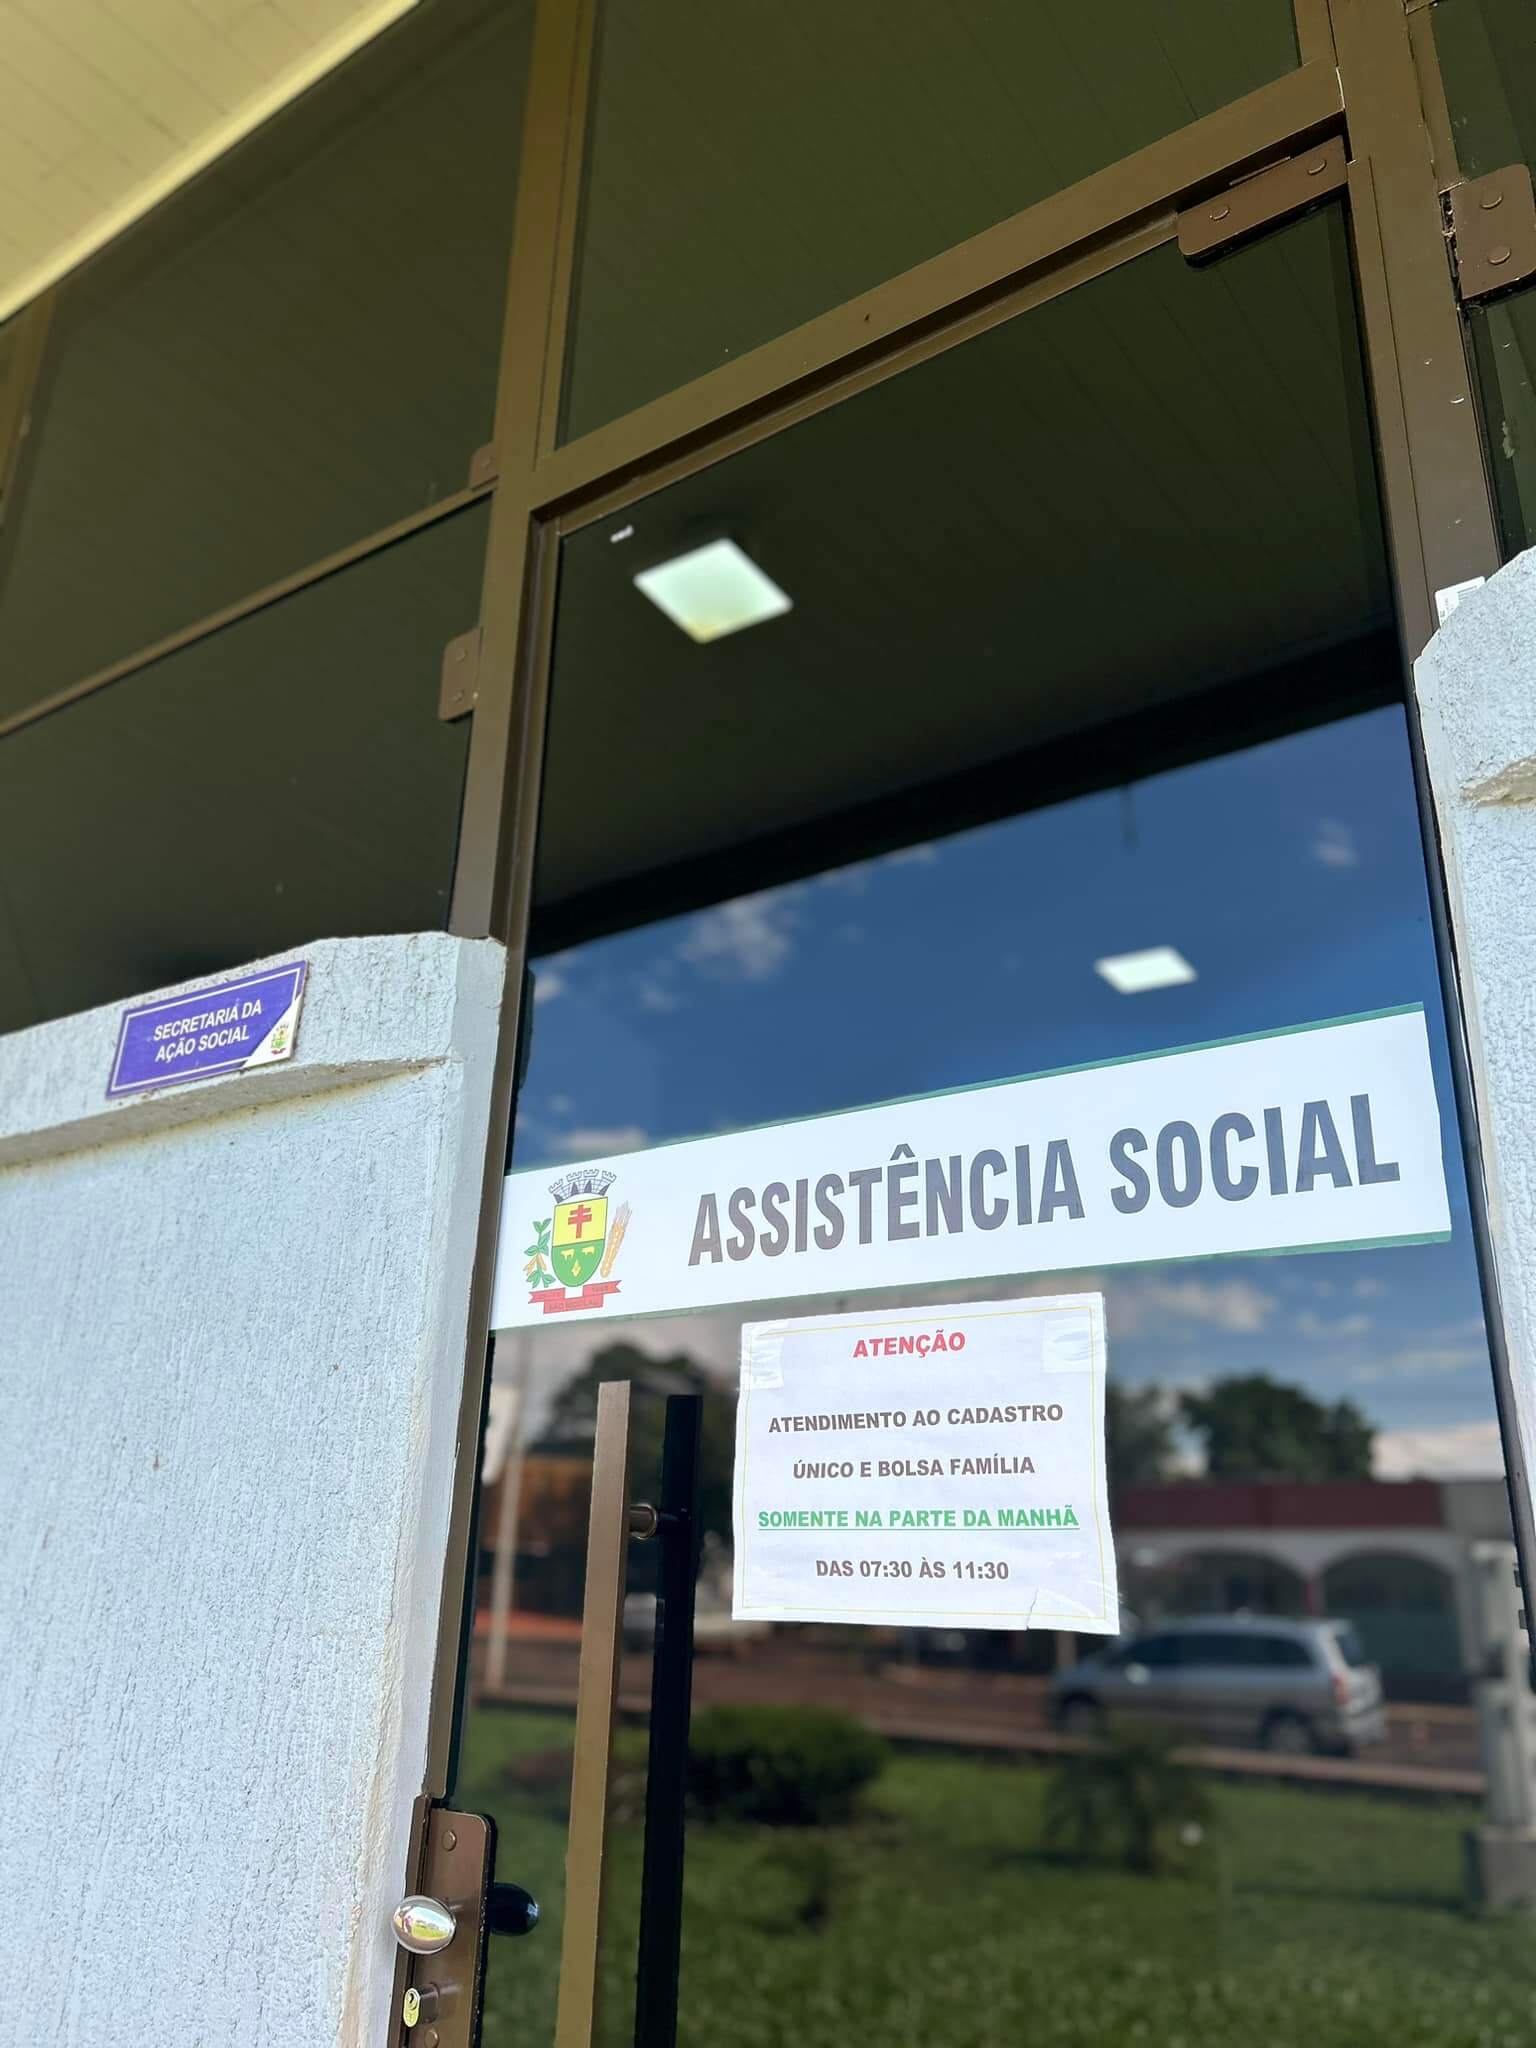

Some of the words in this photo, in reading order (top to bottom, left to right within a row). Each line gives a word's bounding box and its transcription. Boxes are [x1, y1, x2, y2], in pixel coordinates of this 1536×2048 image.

[153, 1005, 239, 1042] SECRETARIA
[241, 999, 263, 1020] DA
[154, 1036, 196, 1064] AÇÃO
[199, 1024, 250, 1052] SOCIAL
[688, 1139, 1086, 1266] ASSISTÊNCIA
[1109, 1093, 1400, 1214] SOCIAL
[852, 1328, 967, 1359] ATENÇÃO
[768, 1410, 907, 1434] ATENDIMENTO
[912, 1408, 942, 1427] AO
[947, 1403, 1064, 1425] CADASTRO
[793, 1458, 854, 1480] ÚNICO
[859, 1461, 872, 1478] E
[878, 1459, 944, 1478] BOLSA
[949, 1453, 1036, 1475] FAMÍLIA
[758, 1510, 848, 1528] SOMENTE
[854, 1510, 882, 1527] NA
[888, 1509, 957, 1528] PARTE
[962, 1509, 993, 1527] DA
[999, 1503, 1080, 1527] MANHÃ
[815, 1560, 854, 1578] DAS
[859, 1560, 913, 1580] 07:30
[918, 1556, 946, 1580] ÀS
[951, 1560, 1010, 1581] 11:30
